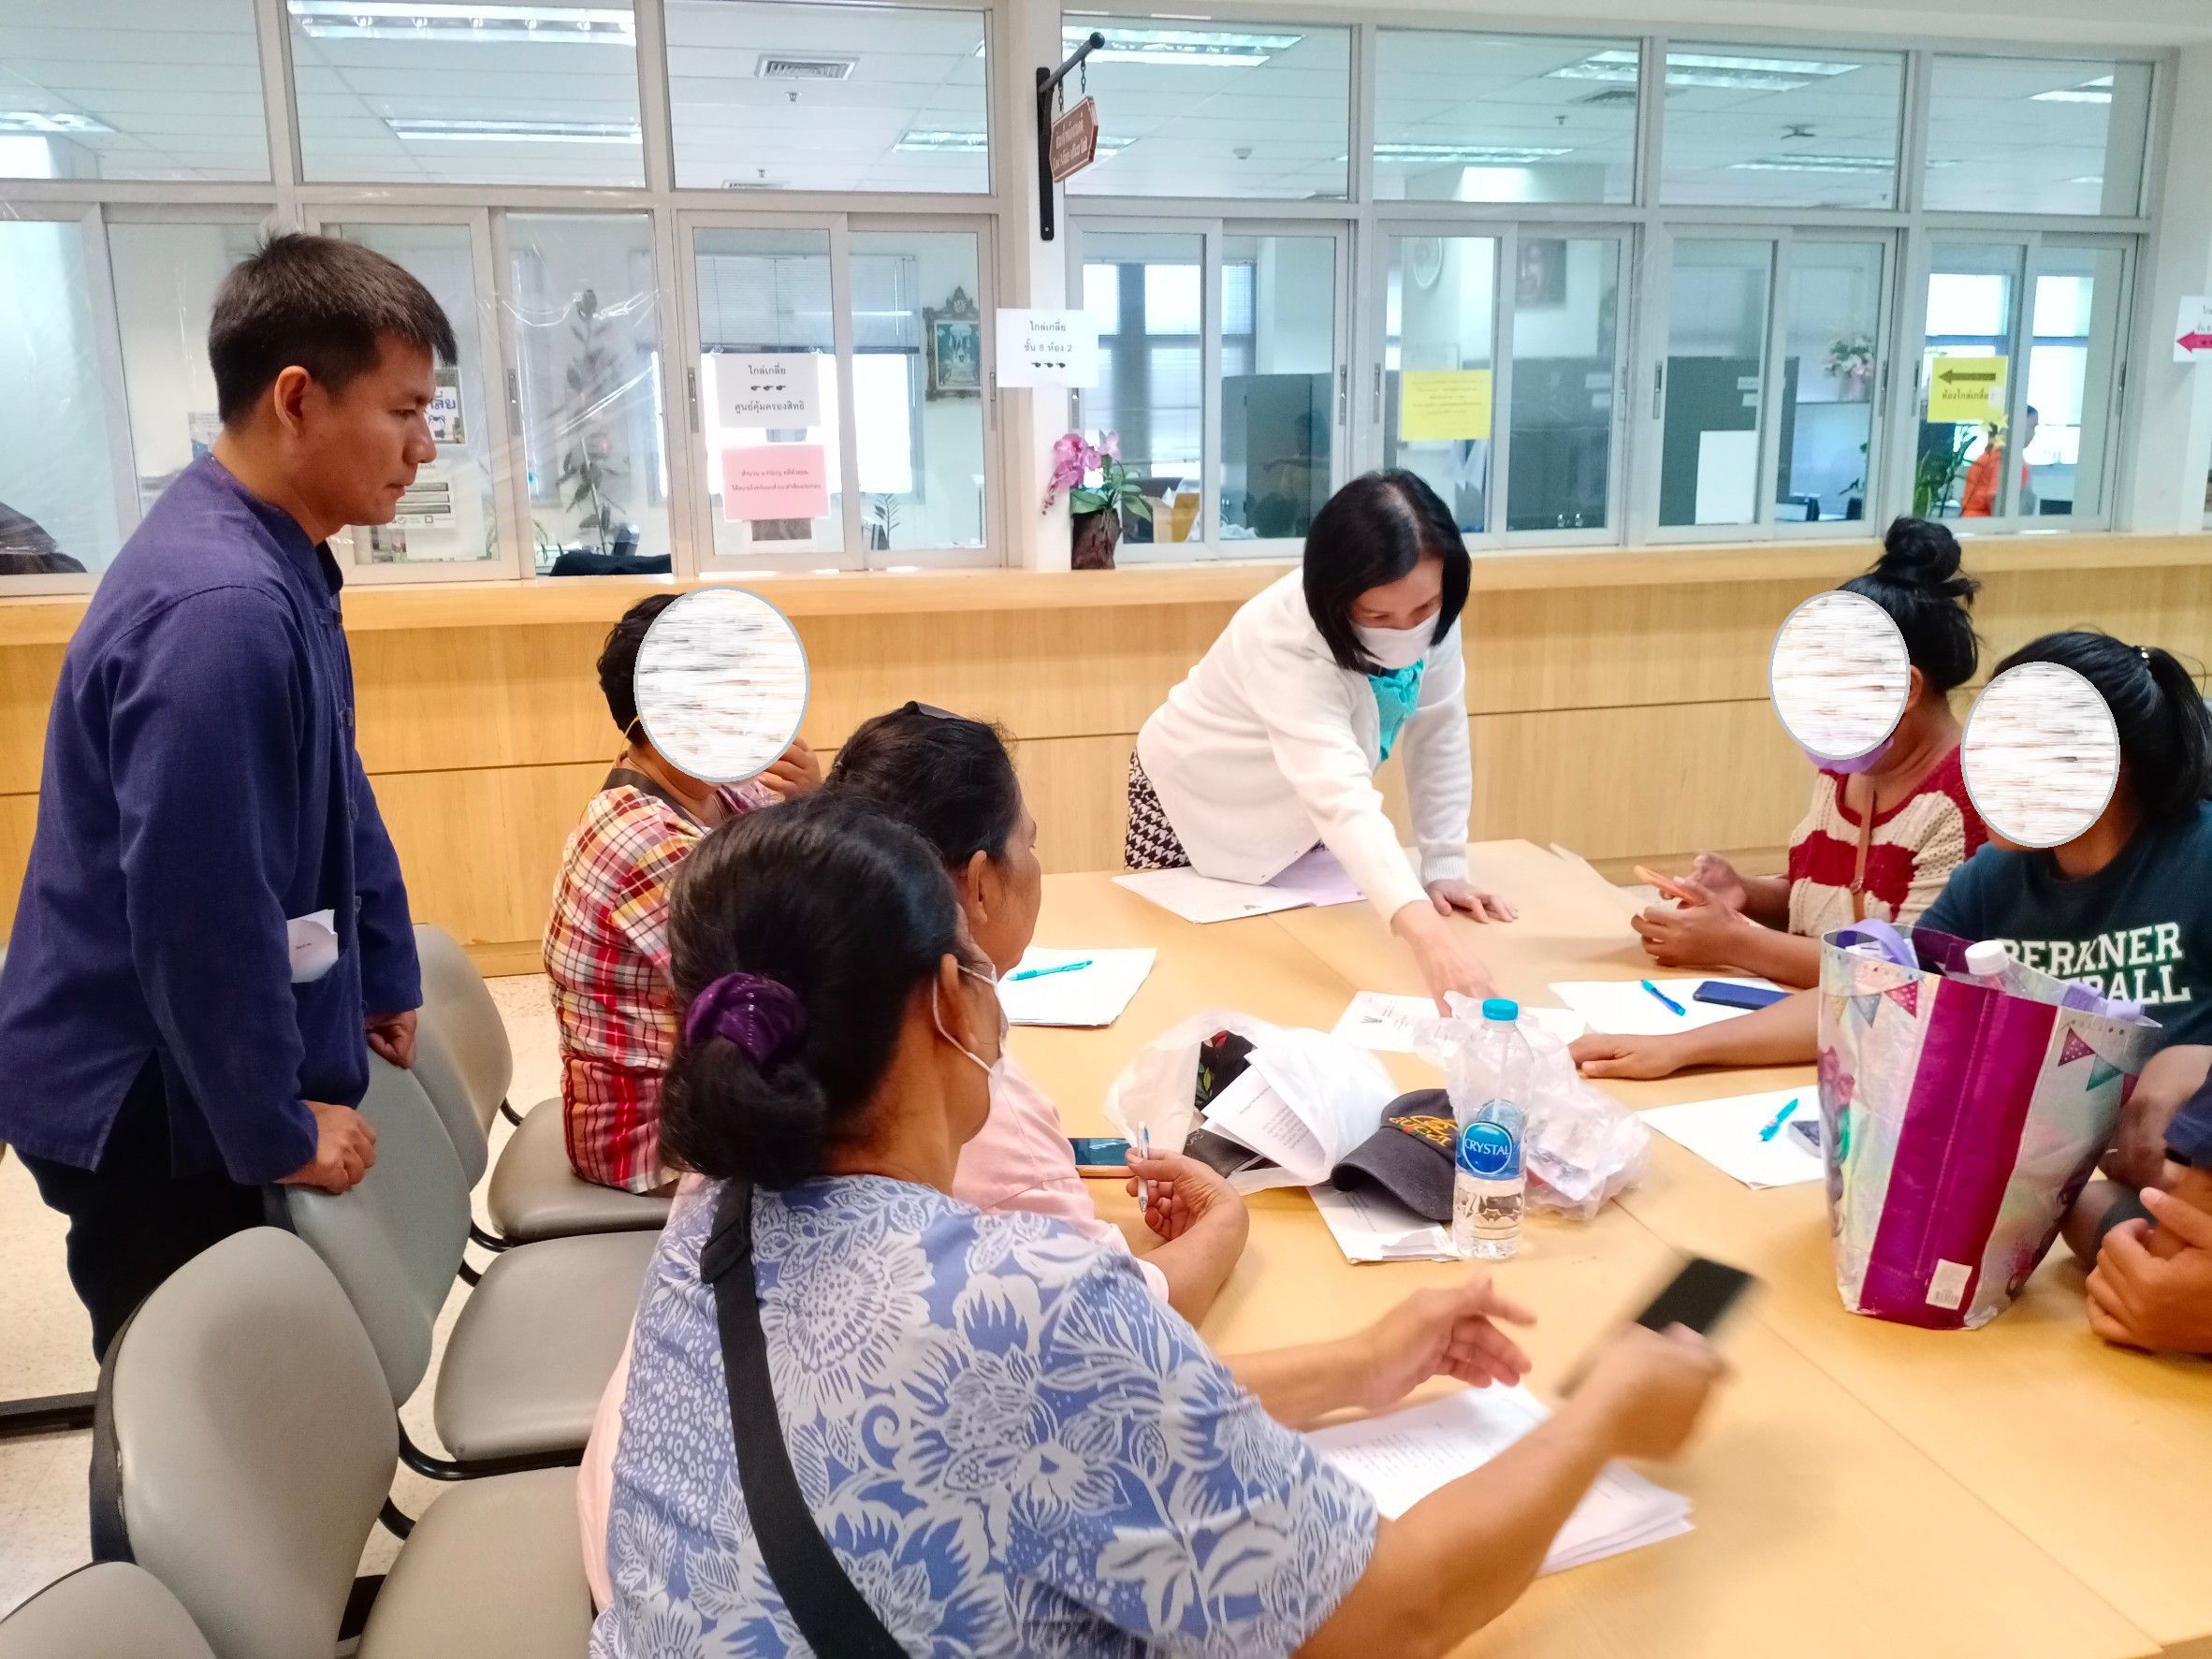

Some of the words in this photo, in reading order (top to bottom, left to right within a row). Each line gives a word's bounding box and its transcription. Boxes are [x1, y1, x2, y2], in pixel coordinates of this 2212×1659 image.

[1029, 318, 1067, 331] ไกล่เกลี่ย
[1024, 338, 1036, 352] ชั้น
[1048, 341, 1064, 352] ห้อง
[748, 362, 786, 375] ไกล่เกลี่ย
[735, 400, 805, 414] ศูนย์คุ้มครองสิทธิ
[1464, 1138, 1509, 1156] CRYSTAL
